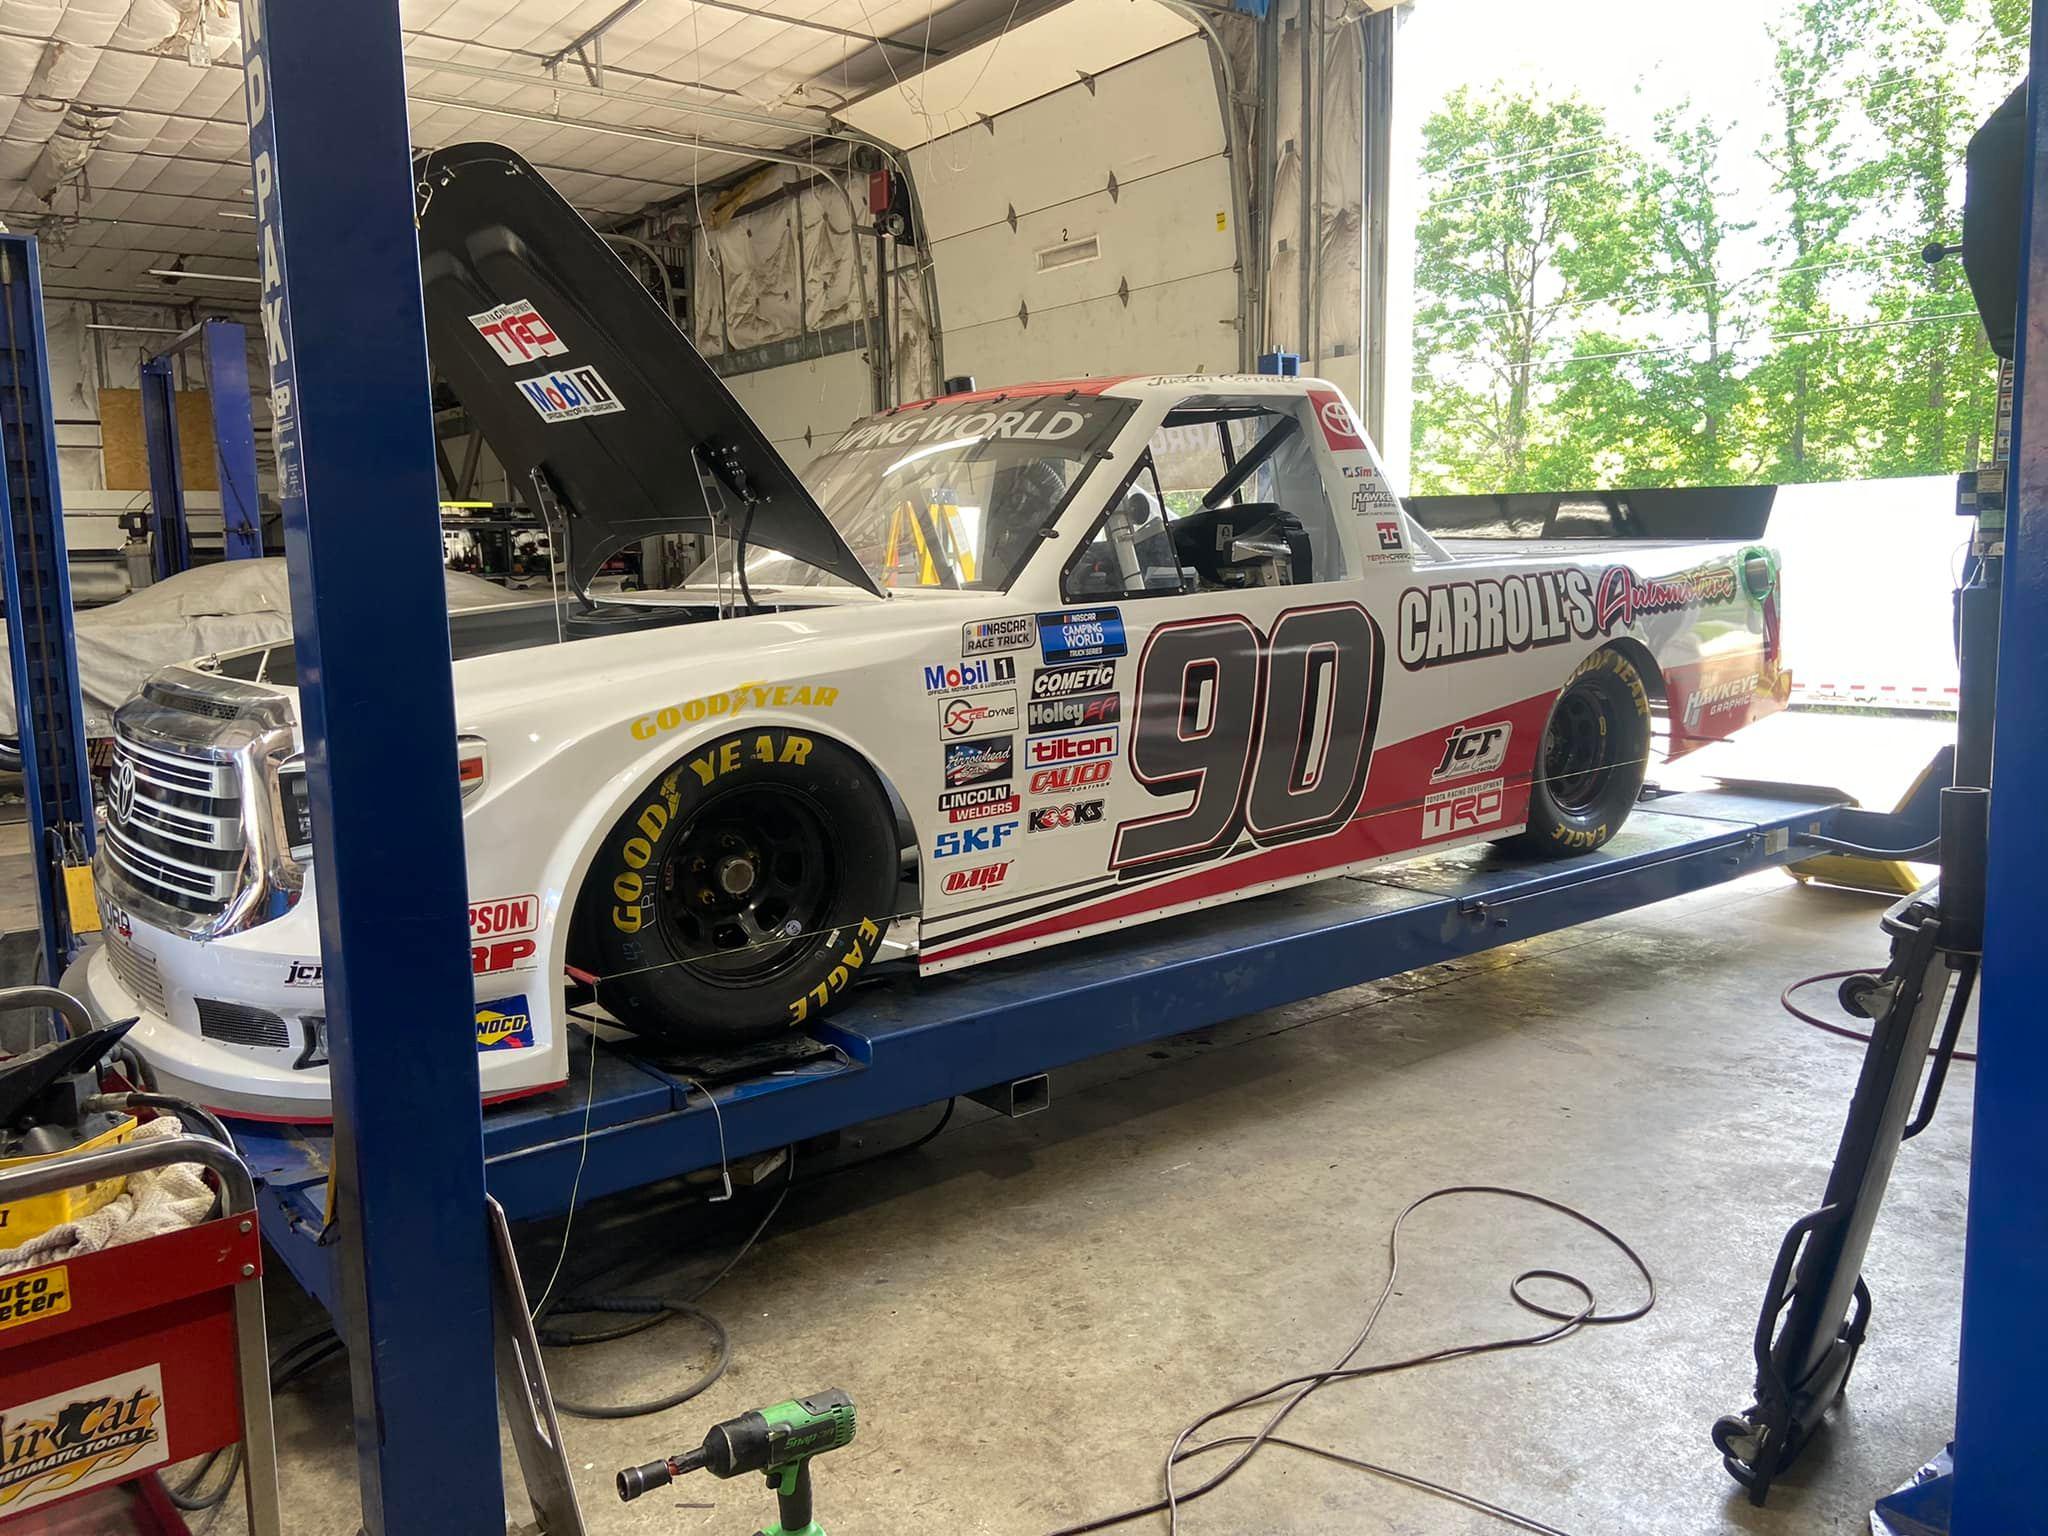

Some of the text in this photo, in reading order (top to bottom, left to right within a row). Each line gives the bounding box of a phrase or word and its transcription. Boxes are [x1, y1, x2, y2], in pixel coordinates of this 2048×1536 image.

[1061, 228, 1069, 242] 2
[254, 151, 288, 367] PAK
[521, 371, 608, 413] Mobl 1
[919, 410, 1086, 441] WORLD
[1354, 465, 1372, 478] Sim
[986, 619, 1027, 636] NASCAR
[1062, 622, 1103, 636] CAMPING
[1071, 612, 1097, 623] NASCAR
[1399, 566, 1736, 671] CARROLL'S Automotive
[967, 633, 1030, 651] RACE TRUCK
[1064, 633, 1105, 648] WORLD
[924, 659, 989, 690] Mobil
[1034, 667, 1114, 694] COMETIC
[1683, 672, 1760, 726] HAWKEYE
[1709, 694, 1755, 716] GRAPHIC
[1028, 702, 1085, 726] Holley
[1032, 737, 1113, 762] tilton
[1108, 600, 1385, 880] 90
[1433, 727, 1502, 775] jcr
[947, 744, 1012, 770] Arrowhead
[1029, 760, 1113, 793] CALICO
[941, 786, 1008, 810] LINCOLN
[1426, 779, 1503, 804] TOYOTA RACING DEVELOPMENT
[955, 802, 1013, 821] WELDERS
[1028, 799, 1105, 834] KOOKS
[1426, 790, 1502, 831] TRD
[933, 821, 1019, 858] SKF
[787, 915, 881, 1027] EAGLE
[85, 1430, 139, 1454] TOOLS
